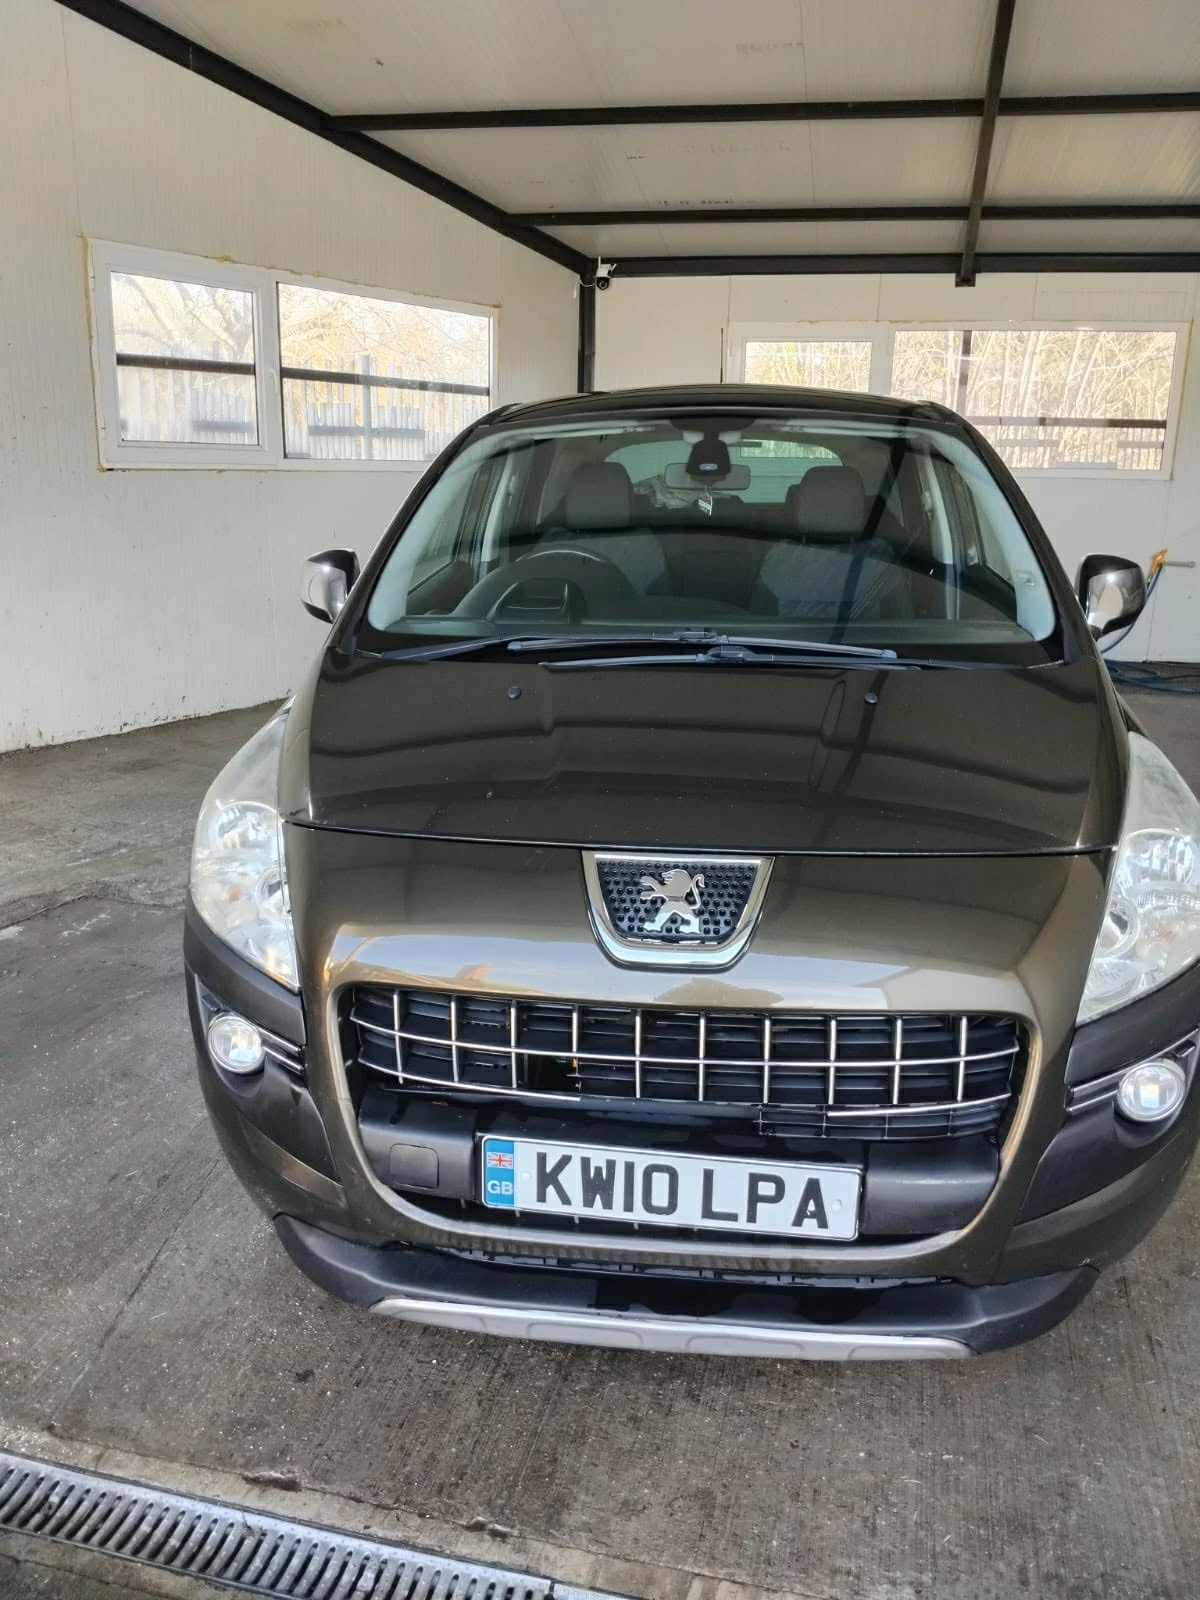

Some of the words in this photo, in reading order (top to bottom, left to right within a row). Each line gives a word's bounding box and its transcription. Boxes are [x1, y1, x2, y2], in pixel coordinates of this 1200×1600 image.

[487, 1179, 513, 1195] GB
[536, 1151, 679, 1216] KW10
[700, 1167, 829, 1229] LPA
